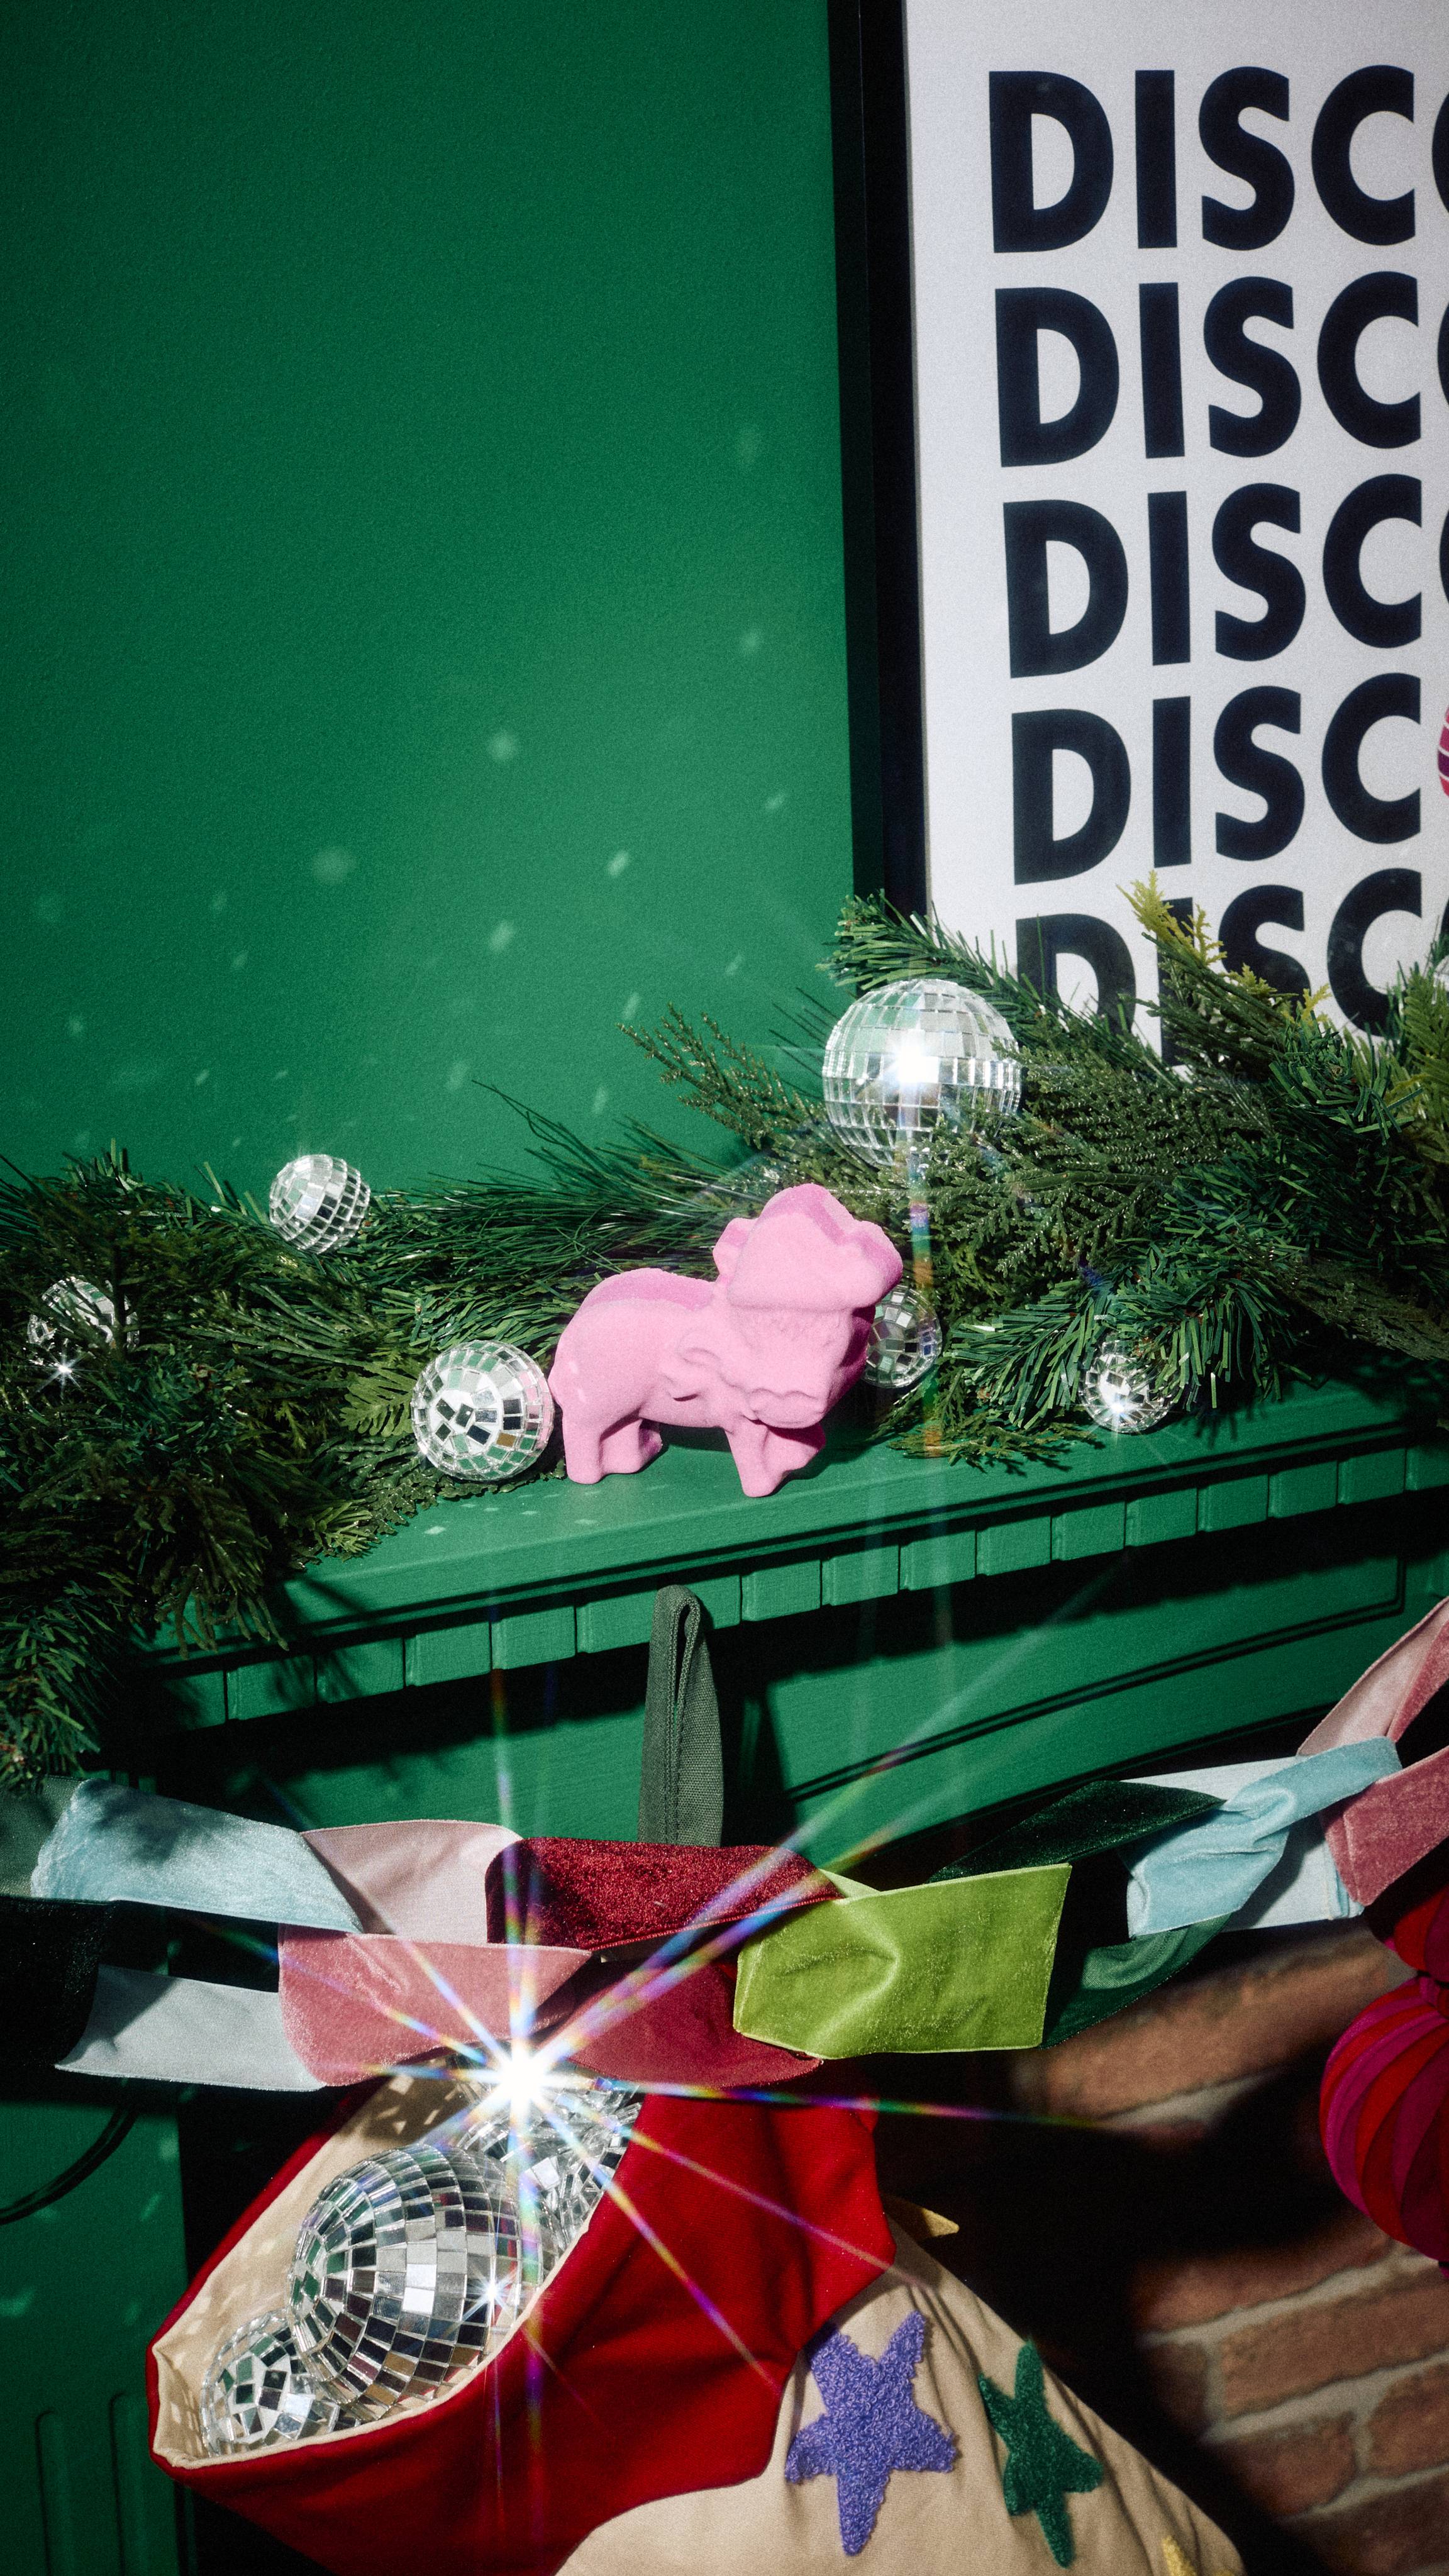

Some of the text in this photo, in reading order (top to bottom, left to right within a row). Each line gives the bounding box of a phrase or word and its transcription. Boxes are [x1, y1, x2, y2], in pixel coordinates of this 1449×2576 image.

[989, 65, 1449, 253] DISC
[996, 272, 1449, 467] DISC
[1004, 474, 1449, 677] DISC
